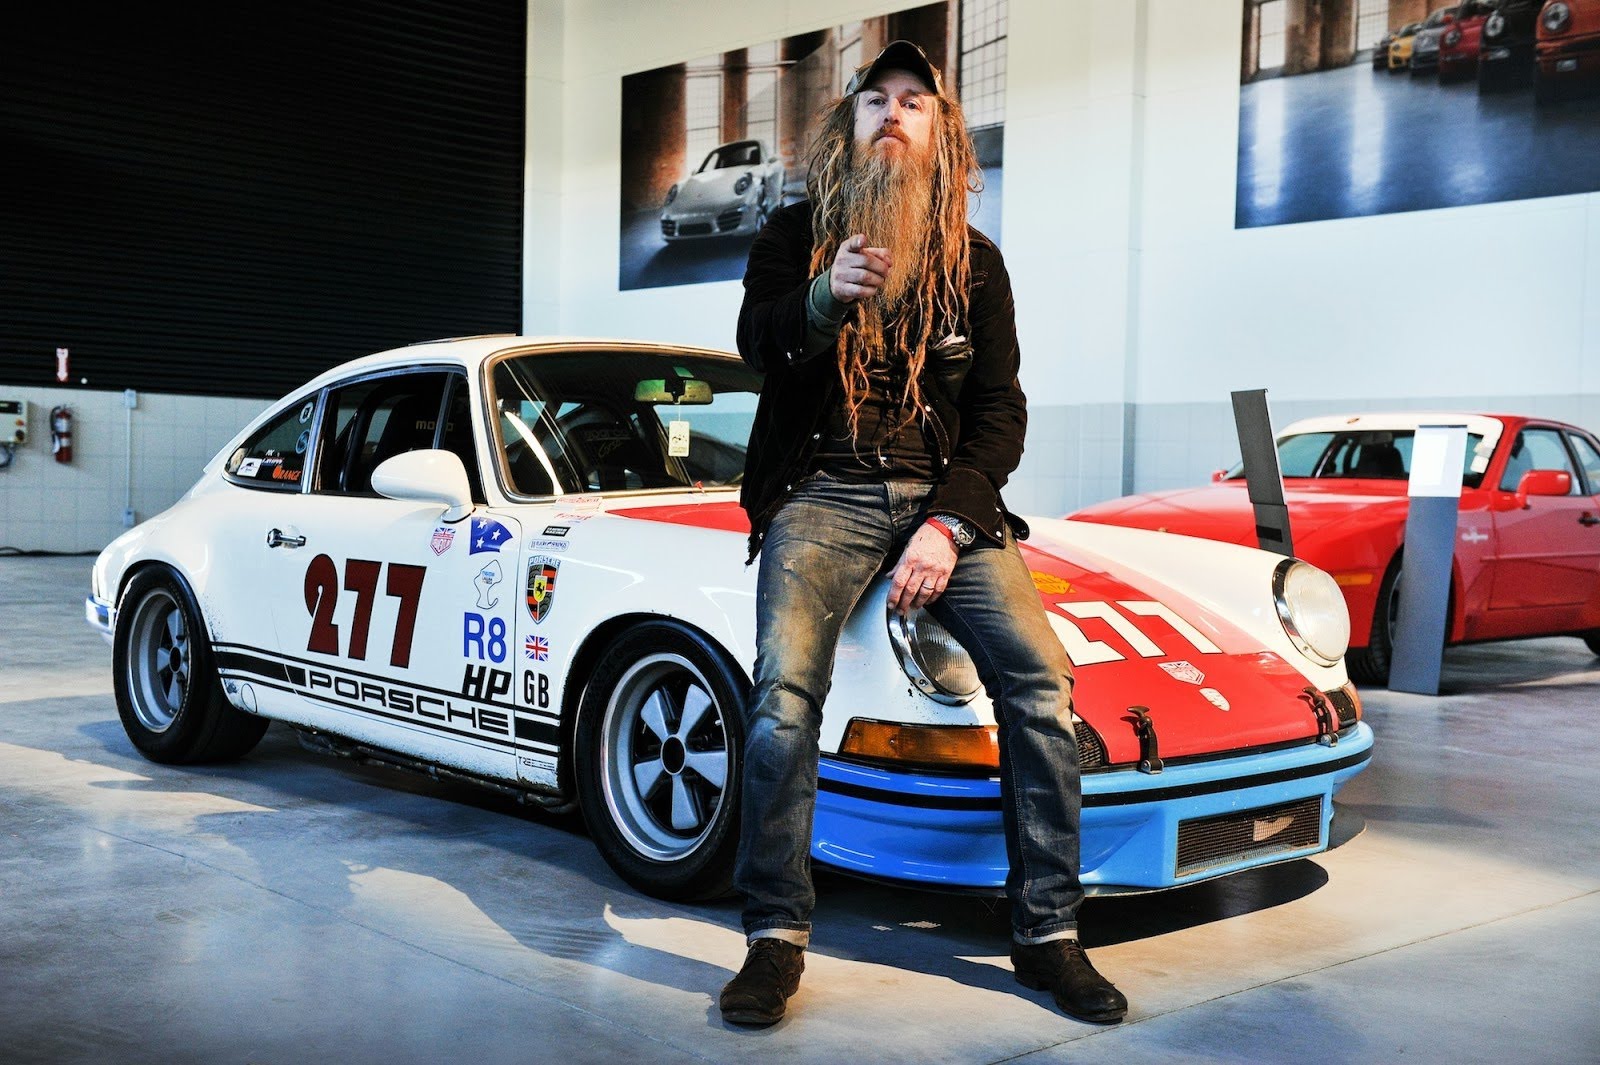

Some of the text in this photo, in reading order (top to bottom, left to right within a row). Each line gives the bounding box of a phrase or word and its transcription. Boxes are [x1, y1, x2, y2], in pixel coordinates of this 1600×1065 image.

[415, 419, 454, 432] moo
[528, 554, 561, 567] PORSCHE
[304, 553, 427, 669] 277
[463, 612, 507, 663] R8
[462, 664, 512, 701] HP
[524, 669, 549, 709] GB
[309, 670, 509, 736] PORSCHE
